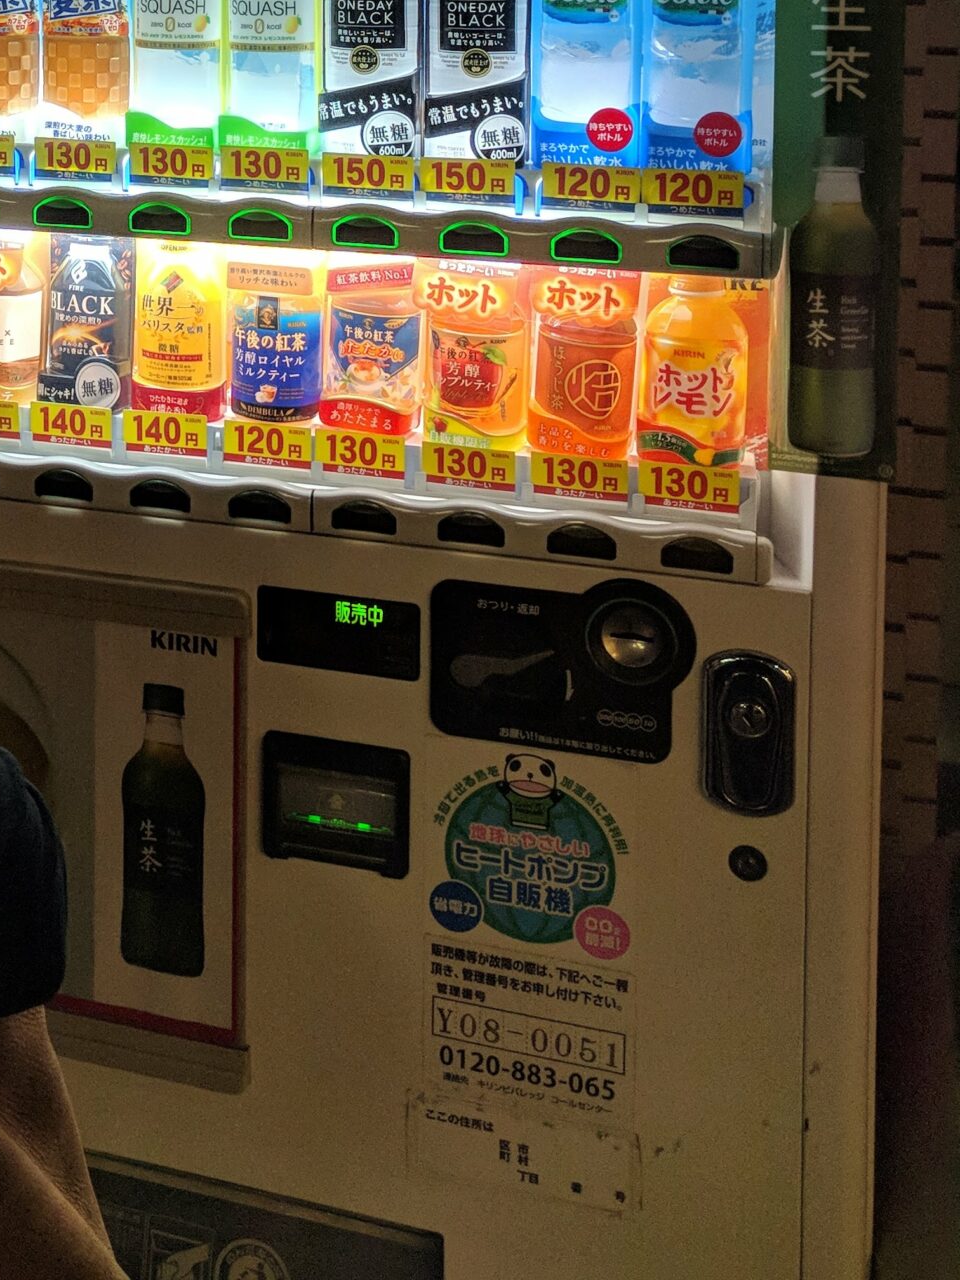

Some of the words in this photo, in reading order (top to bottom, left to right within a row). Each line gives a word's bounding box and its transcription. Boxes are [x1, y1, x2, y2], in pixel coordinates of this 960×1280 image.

[140, 0, 206, 14] SQUASH
[232, 0, 297, 16] SQUASH
[338, 0, 394, 11] ONEDAY
[338, 11, 394, 25] BLACK
[448, 1, 505, 13] ONEDAY
[448, 13, 505, 27] BLACK
[319, 94, 413, 120] 常温でもうまい。
[428, 96, 524, 125] 常温でもうまい。
[369, 123, 409, 144] 無糖
[481, 126, 520, 148] 無糖
[44, 141, 108, 172] 130円
[540, 142, 589, 155] まろやかで
[540, 154, 623, 167] おいしい軟水
[139, 147, 205, 178] 130円
[230, 149, 300, 181] 130円
[332, 157, 404, 189] 150円
[648, 158, 728, 171] おいしい軟水
[431, 161, 506, 192] 150円
[554, 167, 631, 201] 120円
[654, 172, 734, 206] 120円
[238, 276, 298, 288] リッチな味わい
[336, 272, 381, 285] 紅茶飲料
[385, 269, 409, 281] No.1
[51, 290, 115, 315] BLACK
[427, 276, 496, 313] ホット
[547, 279, 620, 317] ホット
[807, 288, 836, 349] 生茶
[234, 326, 307, 352] 午後の紅茶
[344, 324, 394, 343] 午後の紅茶
[235, 348, 305, 367] 芳醇ロイヤル
[673, 349, 705, 360] KIRIN
[81, 377, 114, 398] 無糖
[236, 365, 300, 383] ミルクティー
[551, 347, 566, 410] ほうじ茶
[658, 363, 724, 393] ホット
[654, 387, 733, 417] レモン
[40, 406, 103, 438] 140円
[133, 414, 198, 446] 140円
[331, 410, 392, 431] あたたまる
[234, 424, 302, 458] 120円
[326, 434, 395, 468] 130円
[539, 437, 610, 457] 香りを楽しむ
[433, 447, 506, 481] 130円
[542, 456, 618, 491] 130円
[651, 467, 729, 503] 130円
[334, 600, 384, 628] 販売中
[477, 599, 540, 617] おつり・返却
[150, 630, 218, 657] KIRIN
[139, 819, 162, 872] 生茶
[469, 823, 591, 858] 地球にやさしい
[453, 841, 609, 890] ヒートポンプ
[434, 897, 479, 918] 省電力
[486, 877, 574, 916] 自販機
[431, 961, 623, 1011] 頂き、管理番号をお申し付け下さい。
[436, 982, 486, 1002] 管理番号
[439, 1044, 616, 1101] 0120-883-065
[425, 1108, 494, 1133] ここの住所は
